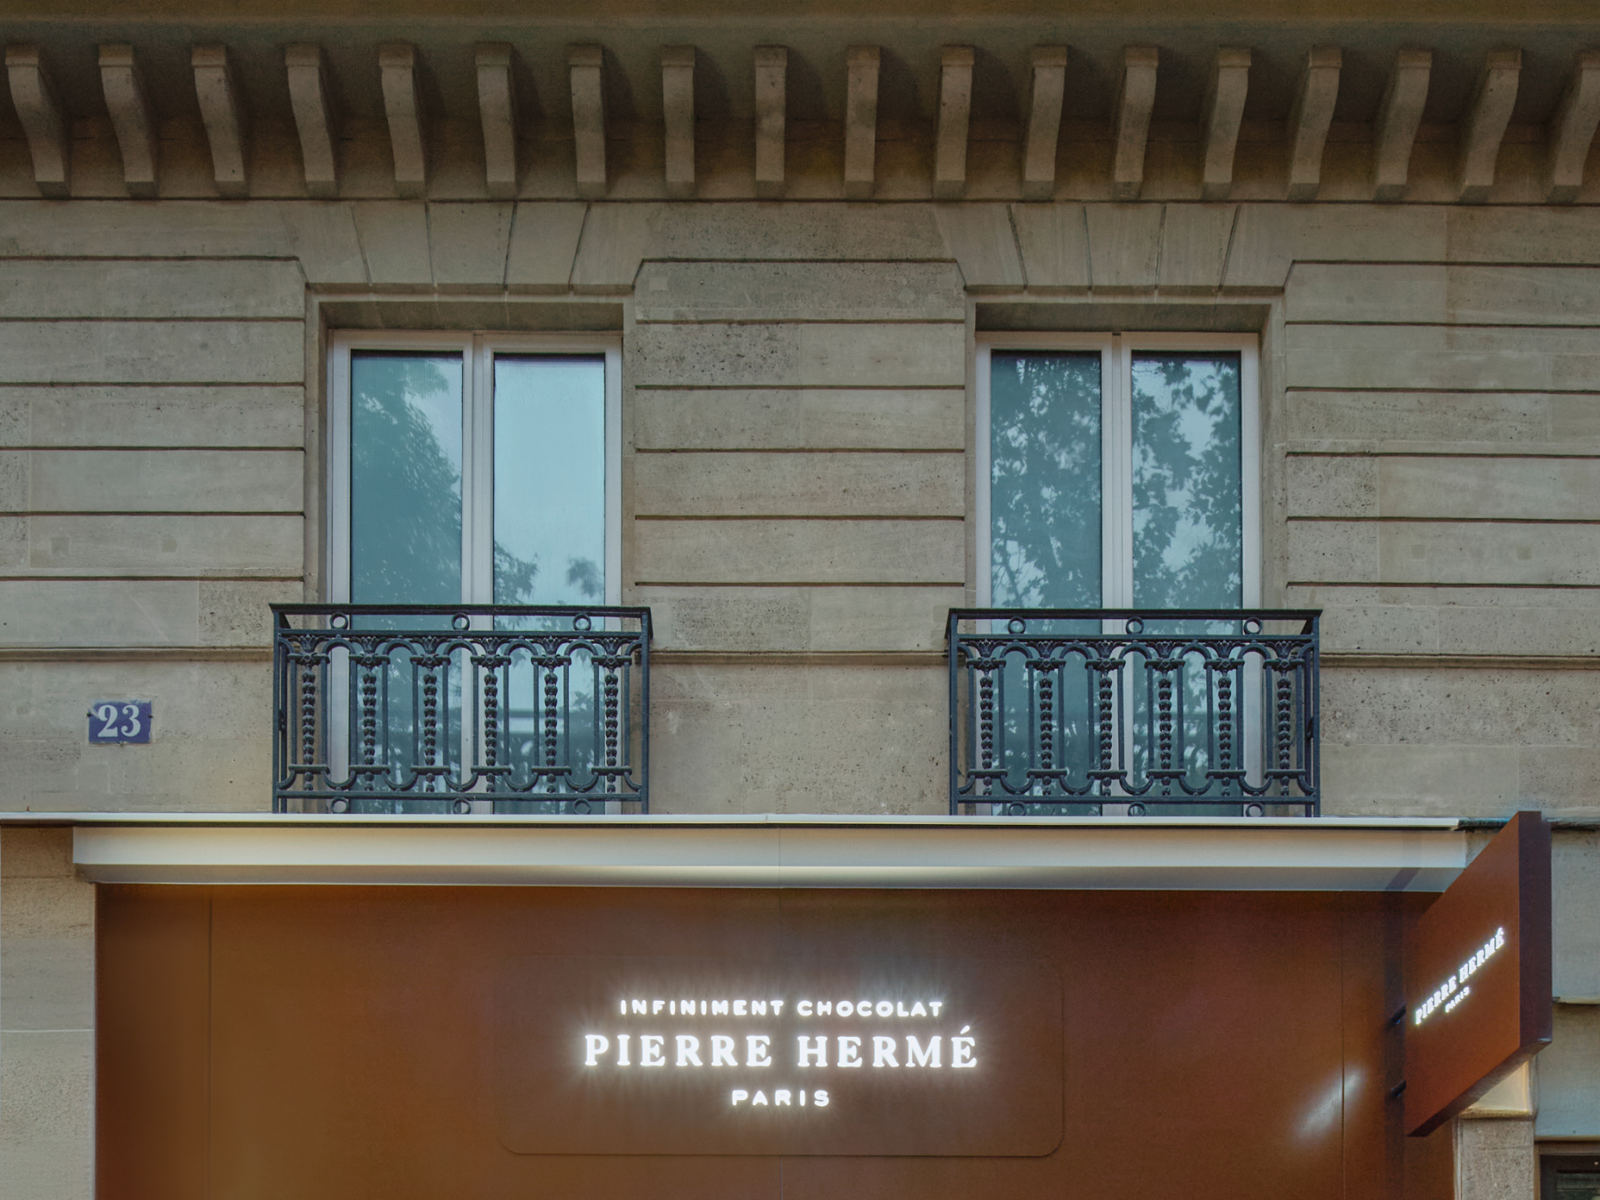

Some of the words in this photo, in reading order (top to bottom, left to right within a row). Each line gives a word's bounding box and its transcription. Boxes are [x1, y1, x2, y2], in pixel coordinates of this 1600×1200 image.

[98, 704, 141, 738] 23
[1415, 975, 1457, 1025] PIERRE
[1459, 926, 1505, 984] HERMÉ
[620, 999, 785, 1017] INFINIMENT
[796, 999, 943, 1018] CHOCOLAT
[584, 1033, 773, 1068] PIERRE
[796, 1024, 978, 1069] HERMÉ
[731, 1089, 830, 1107] PARIS
